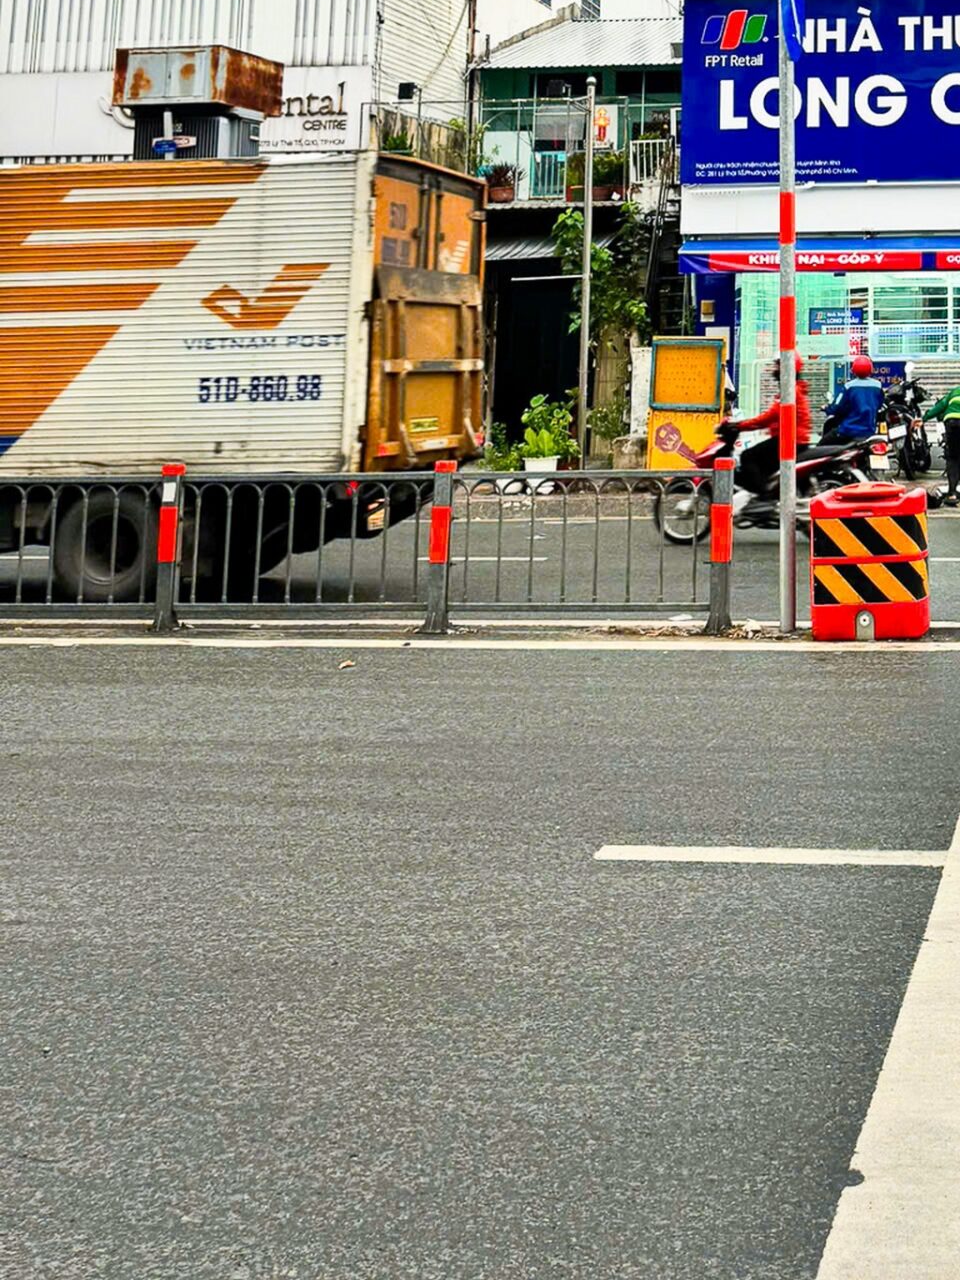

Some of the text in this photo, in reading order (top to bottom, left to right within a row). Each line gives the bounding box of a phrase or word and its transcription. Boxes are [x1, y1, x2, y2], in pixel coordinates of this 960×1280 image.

[705, 53, 764, 67] FPT Retail
[281, 81, 348, 117] ntal
[719, 74, 908, 131] LONG
[302, 119, 347, 131] CENTRE
[749, 251, 781, 265] KHIẾ
[798, 254, 825, 267] NẠI
[838, 252, 871, 265] GÓP
[184, 334, 347, 350] VIETNAM POST
[198, 374, 322, 404] 51D-860.98
